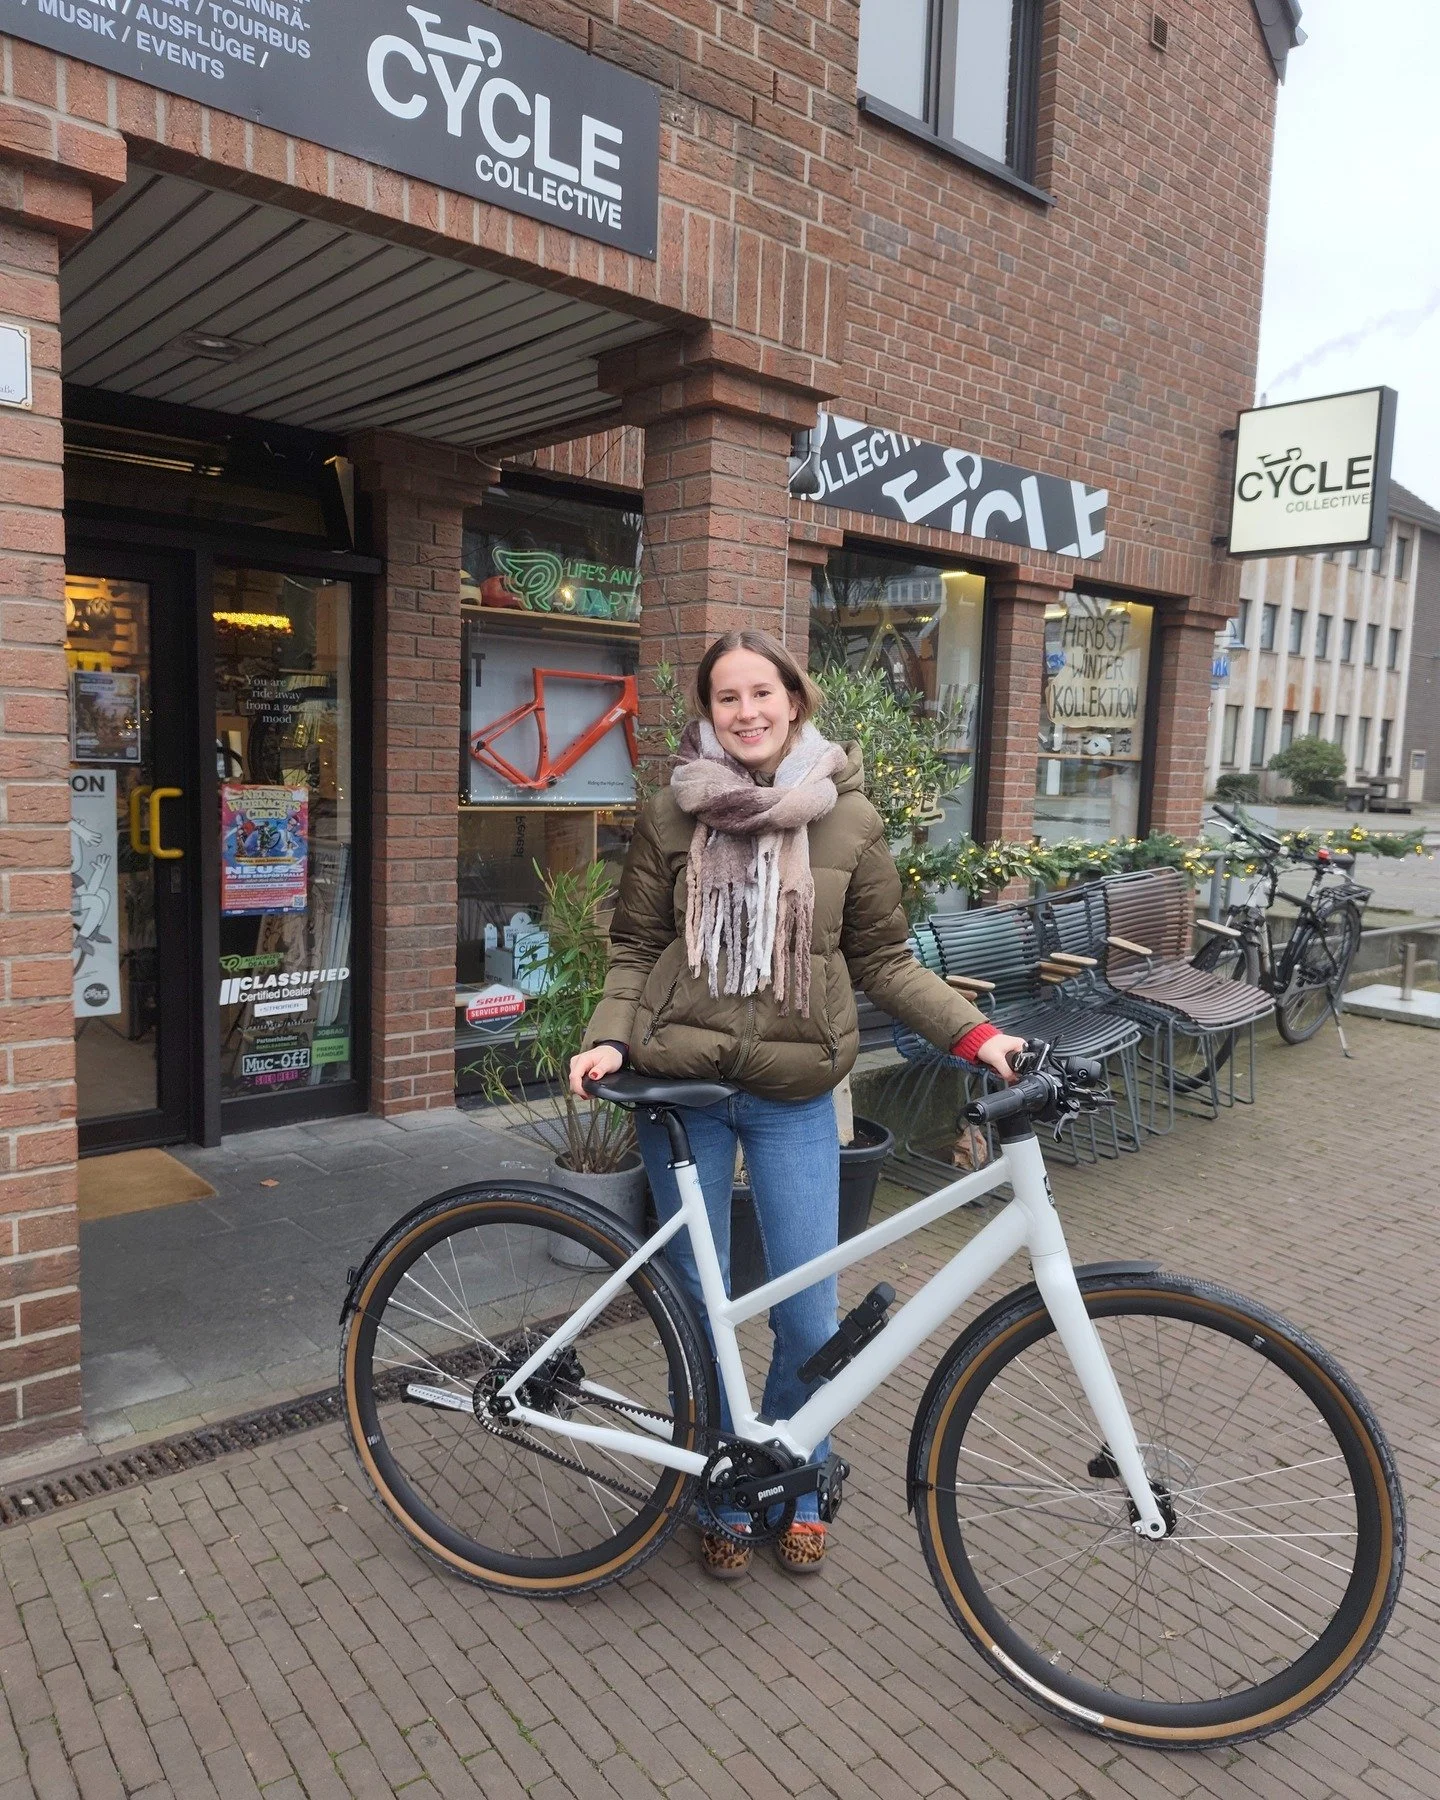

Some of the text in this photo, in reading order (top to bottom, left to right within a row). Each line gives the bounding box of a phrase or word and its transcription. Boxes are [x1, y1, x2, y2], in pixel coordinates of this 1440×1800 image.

[229, 0, 311, 31] NNRÄ-
[38, 0, 117, 40] MUSIK
[136, 30, 225, 80] EVENTS
[135, 2, 256, 65] AUSFLÜGE
[208, 2, 311, 59] TOURBUS
[367, 34, 623, 200] CYCLE
[475, 154, 622, 230] COLLECTIVE
[1237, 455, 1372, 502] CYCLE
[1285, 493, 1371, 514] COLLECTIVE
[567, 561, 632, 585] LIFE'S AN
[1062, 615, 1130, 652] HERBST
[245, 674, 287, 687] You are
[246, 700, 271, 710] from
[252, 688, 301, 702] ride away
[262, 714, 292, 724] mood
[225, 865, 304, 875] NEUSS
[240, 967, 350, 991] CLASSIFIED
[240, 987, 312, 1003] Certified Dealer
[476, 995, 515, 1006] SRAM
[471, 1004, 520, 1018] SERVICE POINT
[316, 1044, 344, 1052] PREMIUM
[245, 1050, 308, 1073] Muc-Off
[255, 1069, 299, 1085] SOLD HERE
[757, 1485, 784, 1502] pinion
